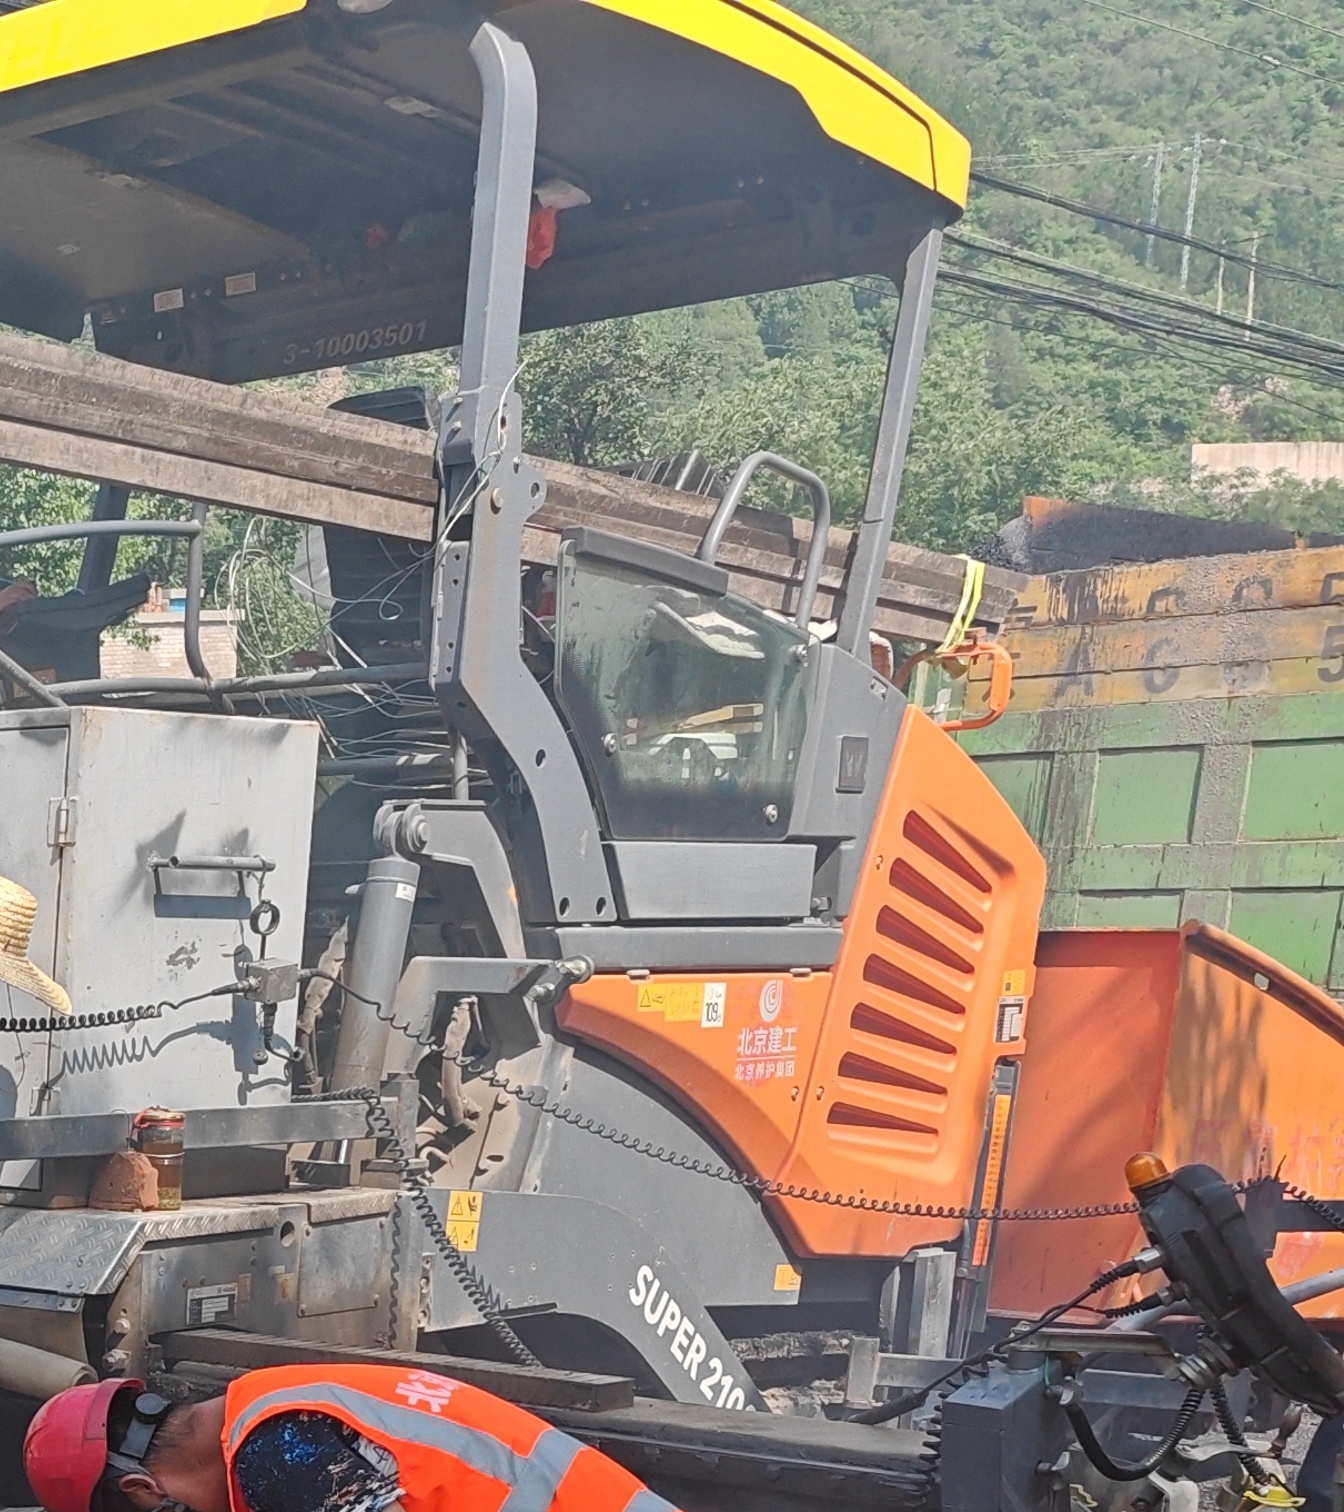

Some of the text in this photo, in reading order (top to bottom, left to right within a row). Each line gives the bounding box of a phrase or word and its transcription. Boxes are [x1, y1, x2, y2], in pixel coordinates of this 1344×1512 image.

[737, 1025, 798, 1055] 北京建工
[629, 1265, 757, 1412] SUPER 210
